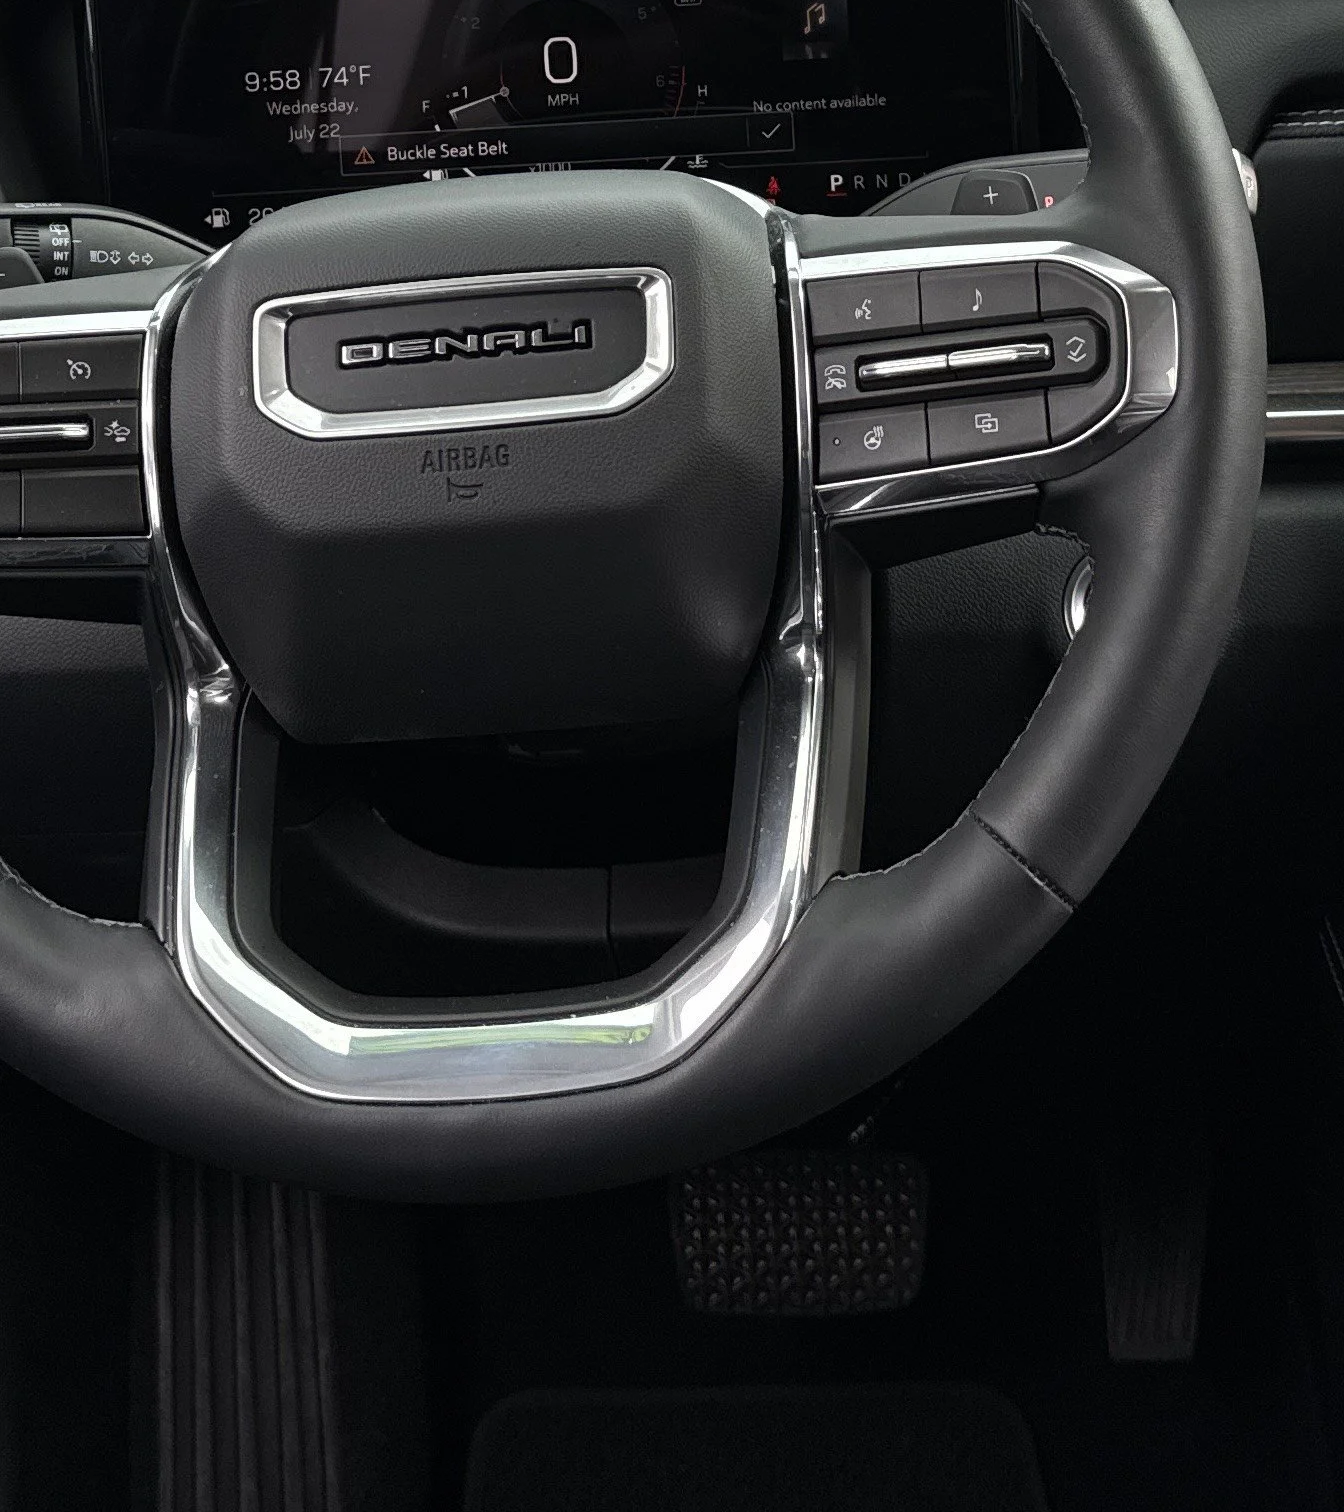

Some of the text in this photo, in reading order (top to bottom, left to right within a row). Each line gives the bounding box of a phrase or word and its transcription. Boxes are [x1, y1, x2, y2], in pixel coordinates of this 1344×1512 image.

[544, 37, 577, 83] 0
[245, 65, 371, 92] 9:58 74°F
[698, 85, 707, 96] H
[423, 100, 429, 112] F
[548, 94, 578, 106] MPH
[753, 92, 887, 113] No content available
[288, 124, 341, 144] July 22
[388, 140, 508, 160] Buckle Seat Belt
[830, 173, 911, 191] P R N D
[1045, 197, 1053, 207] P
[52, 238, 69, 246] OFF
[54, 251, 69, 260] INT
[55, 267, 68, 275] ON
[341, 325, 587, 365] DENALI
[421, 444, 509, 473] AIRBAG
